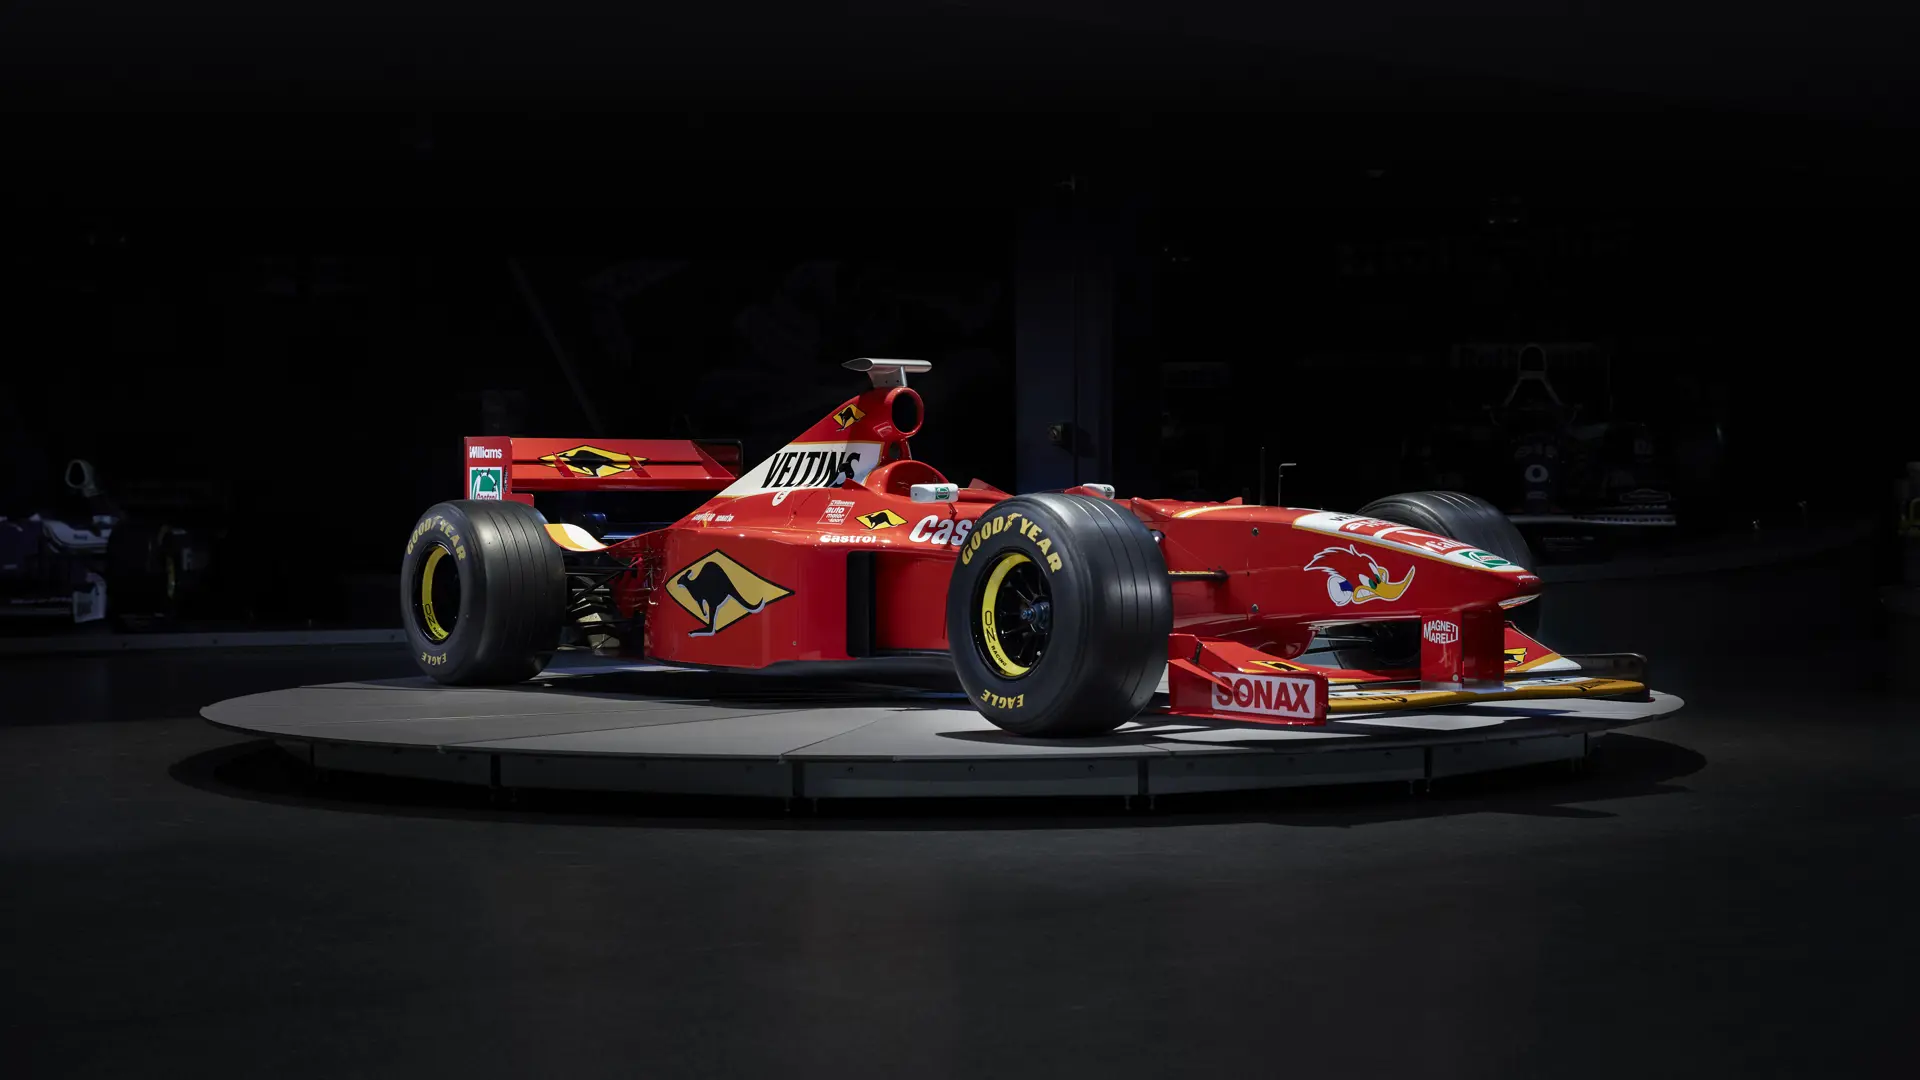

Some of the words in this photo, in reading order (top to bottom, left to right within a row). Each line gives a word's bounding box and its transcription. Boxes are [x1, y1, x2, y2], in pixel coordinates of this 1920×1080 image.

[469, 445, 502, 459] Williams
[761, 451, 861, 488] VELTINS
[825, 506, 845, 514] auto
[820, 534, 877, 543] Castrol
[420, 651, 447, 666] EAGLE
[990, 645, 1007, 667] RACING
[980, 689, 1025, 710] EAGLE
[1214, 676, 1311, 714] SONAX
